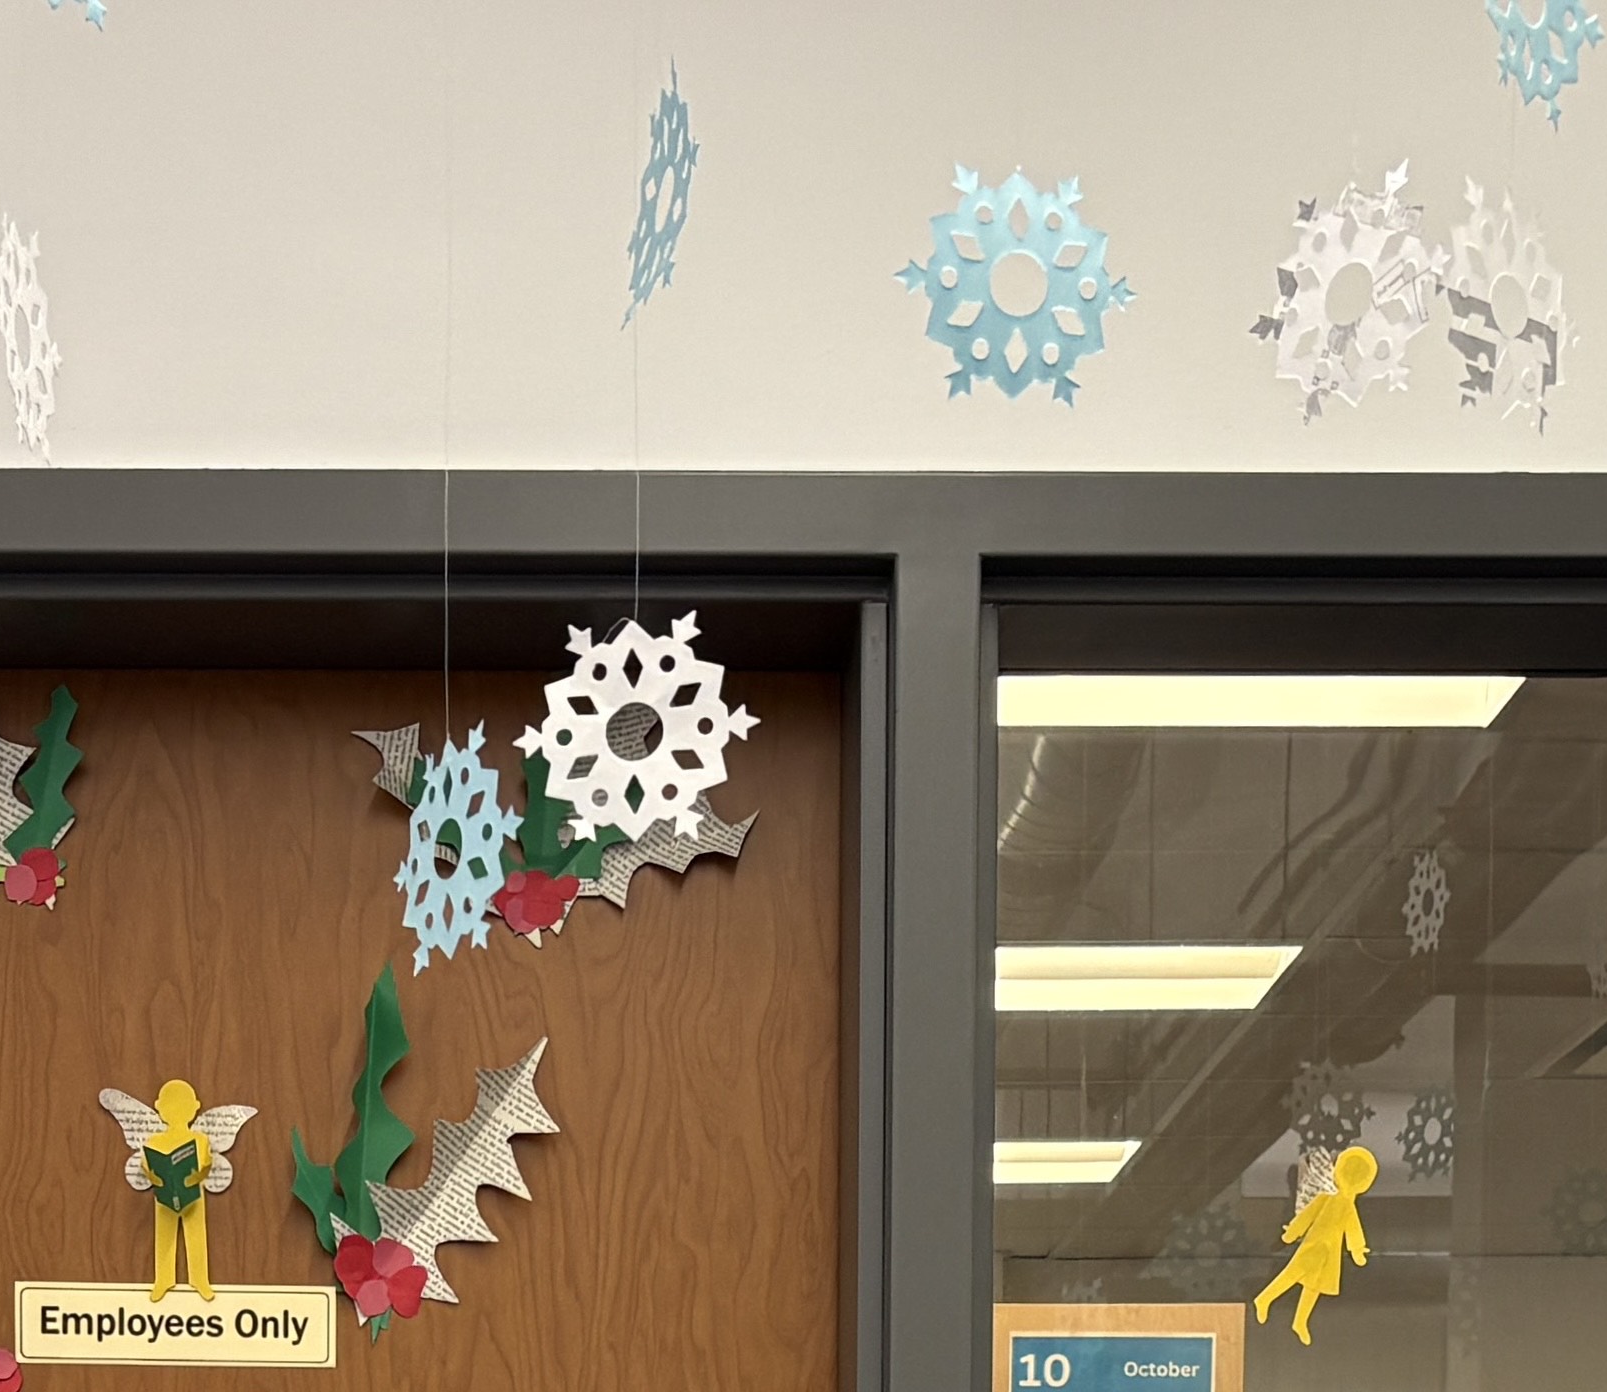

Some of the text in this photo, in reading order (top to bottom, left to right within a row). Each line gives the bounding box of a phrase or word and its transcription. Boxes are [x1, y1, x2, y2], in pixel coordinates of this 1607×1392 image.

[40, 1305, 309, 1346] Employees Only
[1018, 1353, 1200, 1388] 10 October
